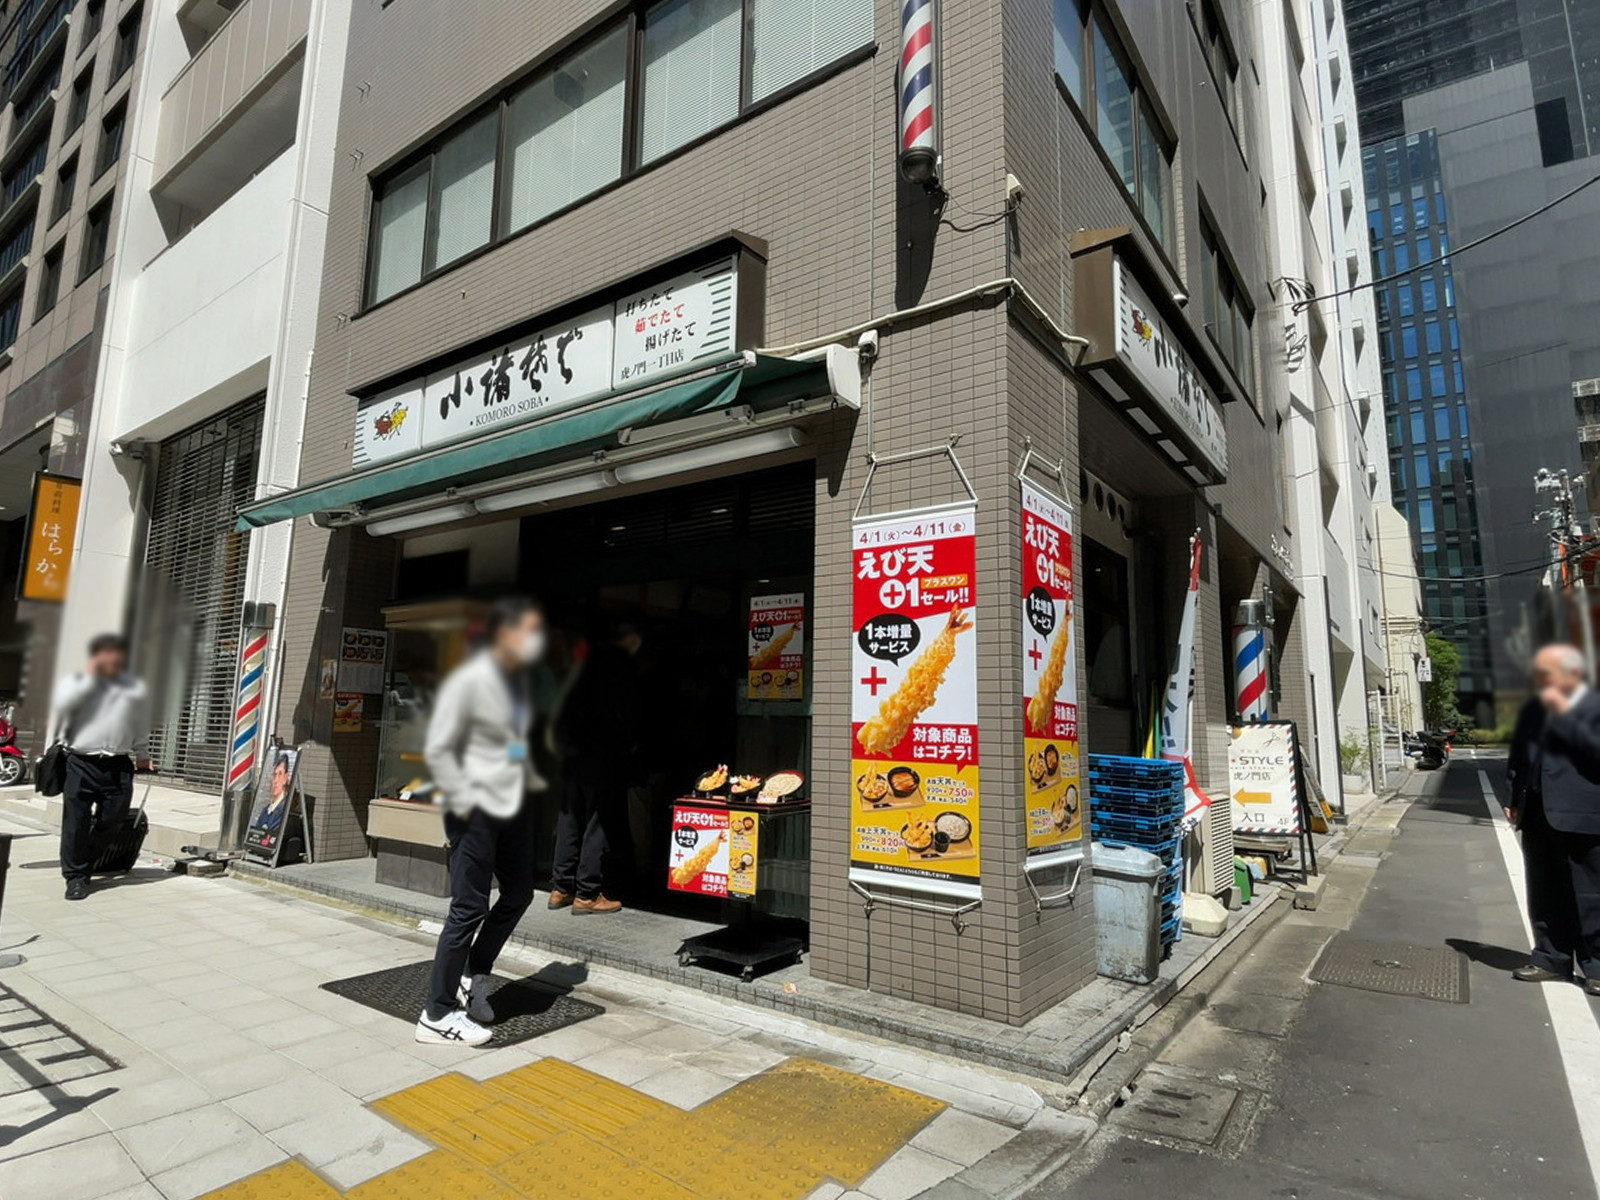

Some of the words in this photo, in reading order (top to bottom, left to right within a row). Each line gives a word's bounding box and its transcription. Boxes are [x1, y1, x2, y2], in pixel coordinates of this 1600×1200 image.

[625, 286, 675, 317] 打ちたて
[635, 303, 685, 334] 茹でたて
[645, 321, 697, 352] 揚げたて
[620, 348, 685, 380] 虎ノ門一丁目店
[475, 403, 516, 427] KOMORO
[517, 396, 544, 413] SOBA
[1024, 515, 1060, 559] えび天
[857, 545, 935, 580] えび天
[923, 577, 966, 588] プラスワン
[921, 587, 969, 606] セール!!
[865, 623, 913, 640] 1本増量
[869, 641, 911, 655] サービス
[913, 727, 973, 745] 対象商品
[913, 745, 973, 761] はコチラ!
[1239, 756, 1285, 766] STYLE
[1234, 771, 1272, 781] 虎ノ門店
[675, 810, 700, 824] えび天
[1241, 812, 1265, 823] 入口
